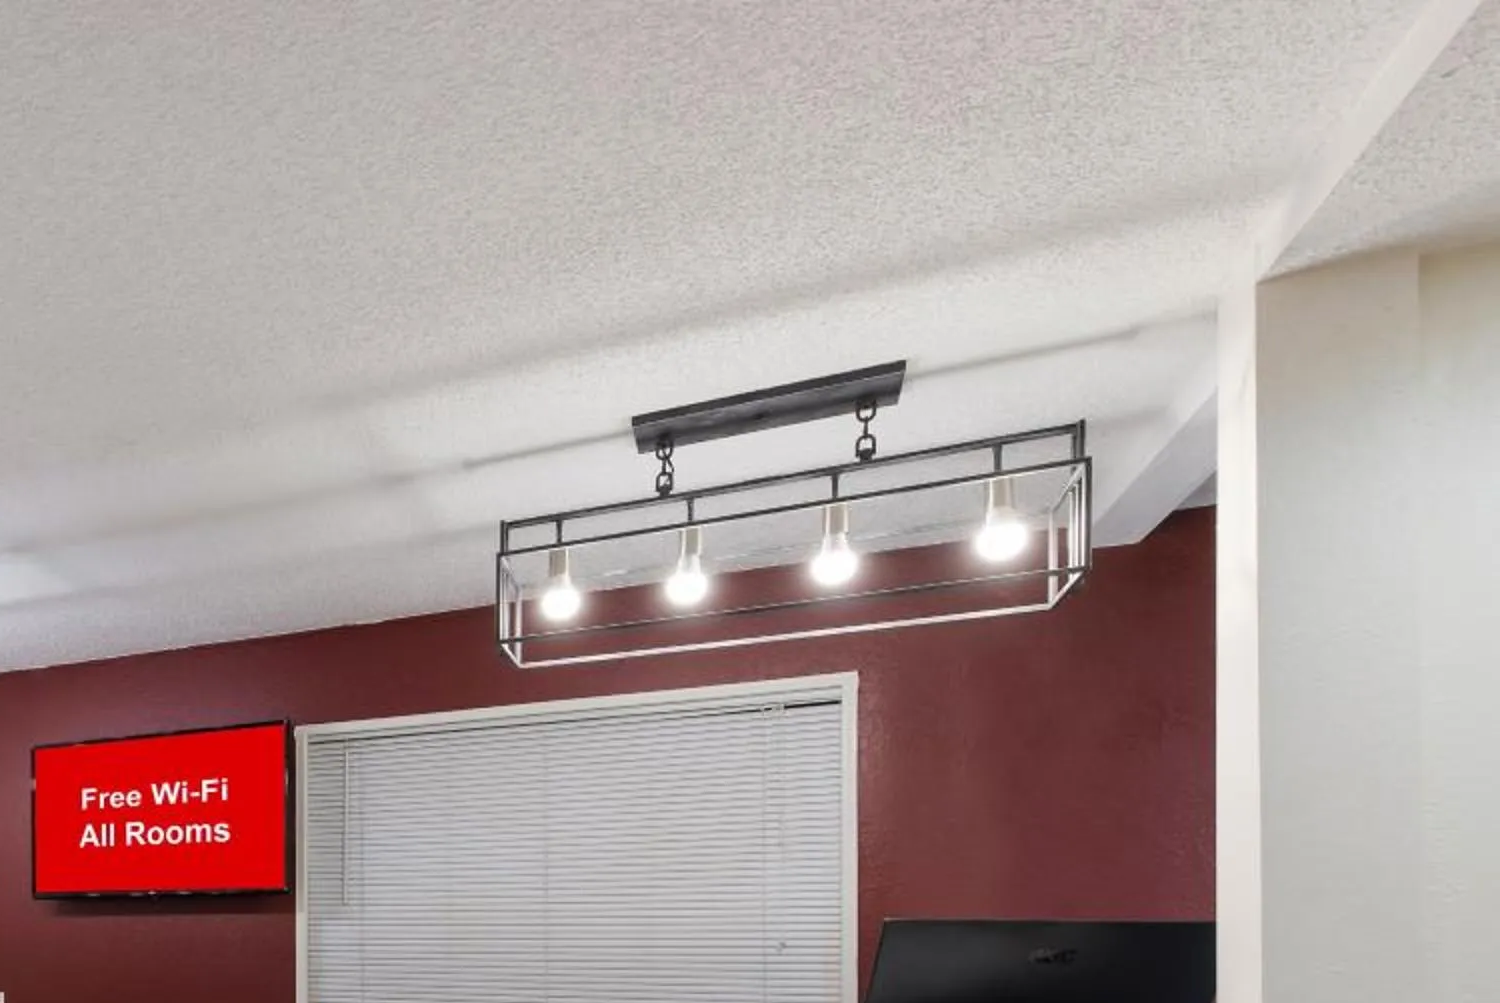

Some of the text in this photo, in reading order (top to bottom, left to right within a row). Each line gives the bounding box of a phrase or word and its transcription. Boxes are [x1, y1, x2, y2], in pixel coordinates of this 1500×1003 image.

[81, 777, 229, 811] Free Wi-Fi
[79, 821, 231, 849] All Rooms
